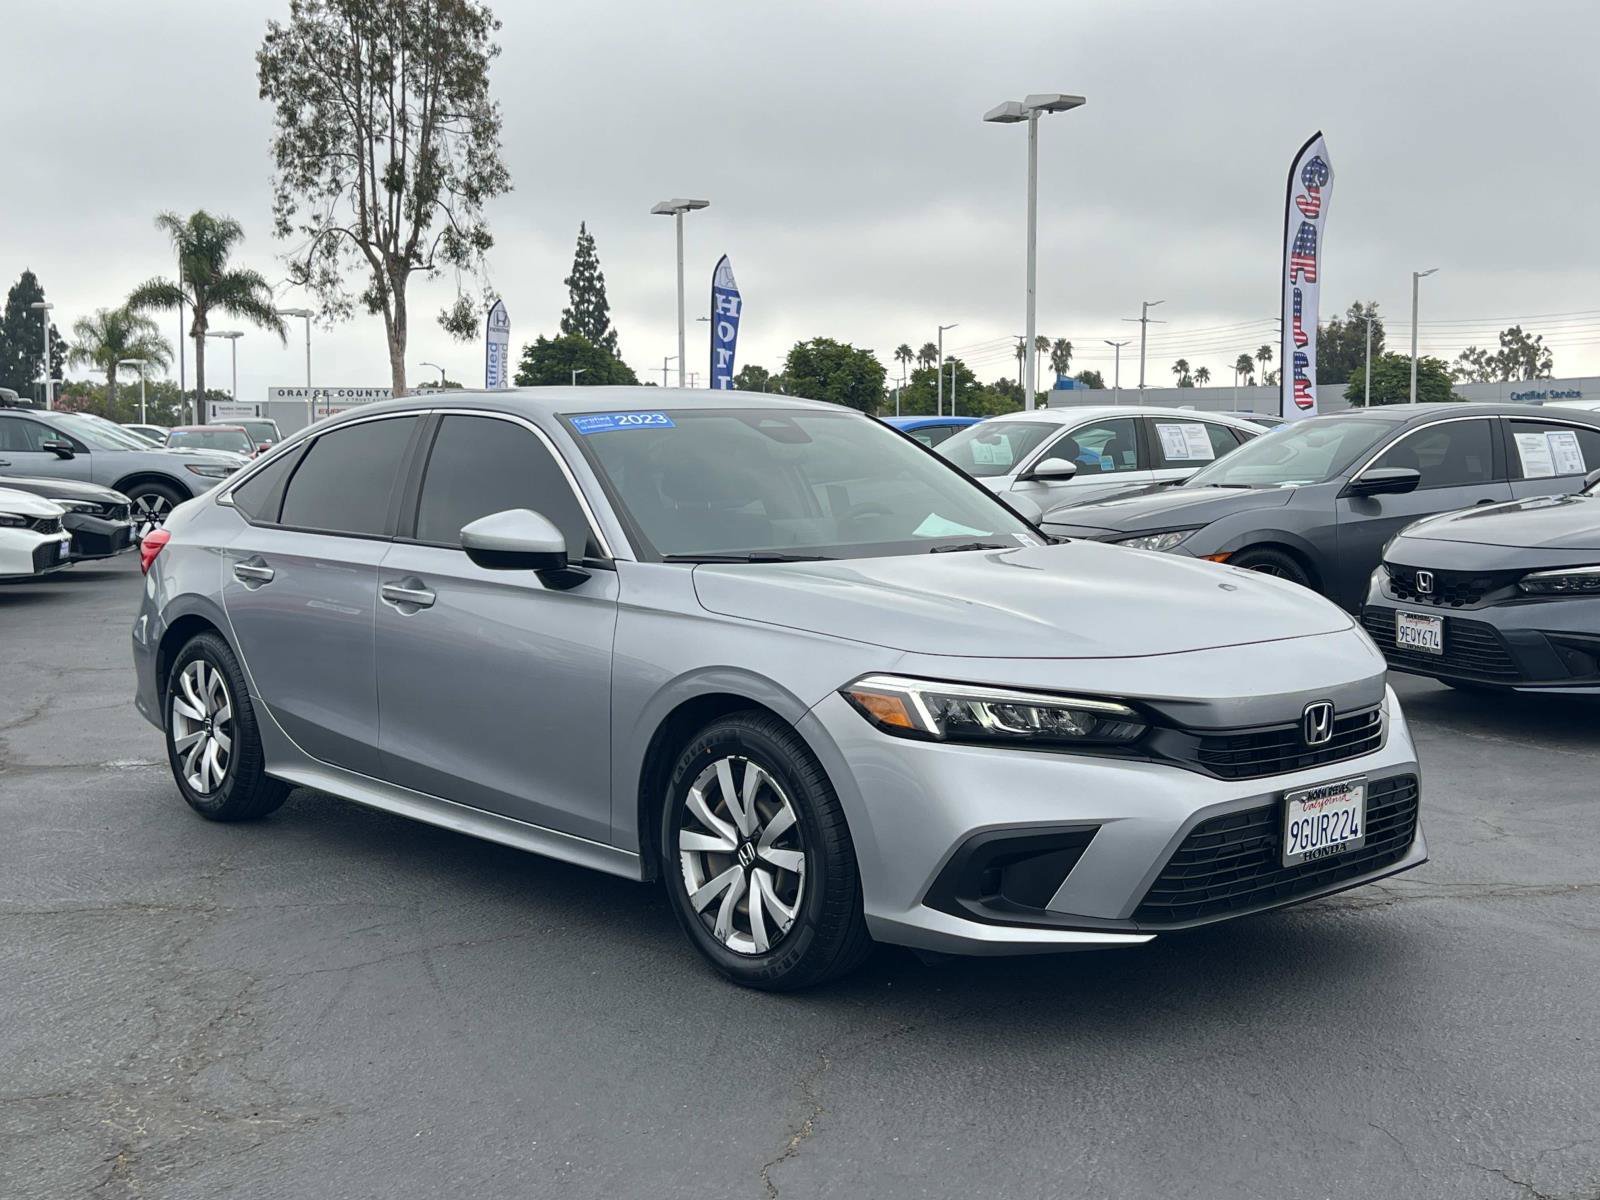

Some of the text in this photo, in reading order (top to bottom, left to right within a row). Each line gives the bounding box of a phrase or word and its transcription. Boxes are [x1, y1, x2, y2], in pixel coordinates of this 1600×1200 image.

[1290, 155, 1329, 412] SALE
[338, 389, 390, 397] COUNTY
[614, 414, 668, 425] 2023
[1289, 807, 1359, 853] 9GUR224
[1303, 842, 1347, 861] HONDA
